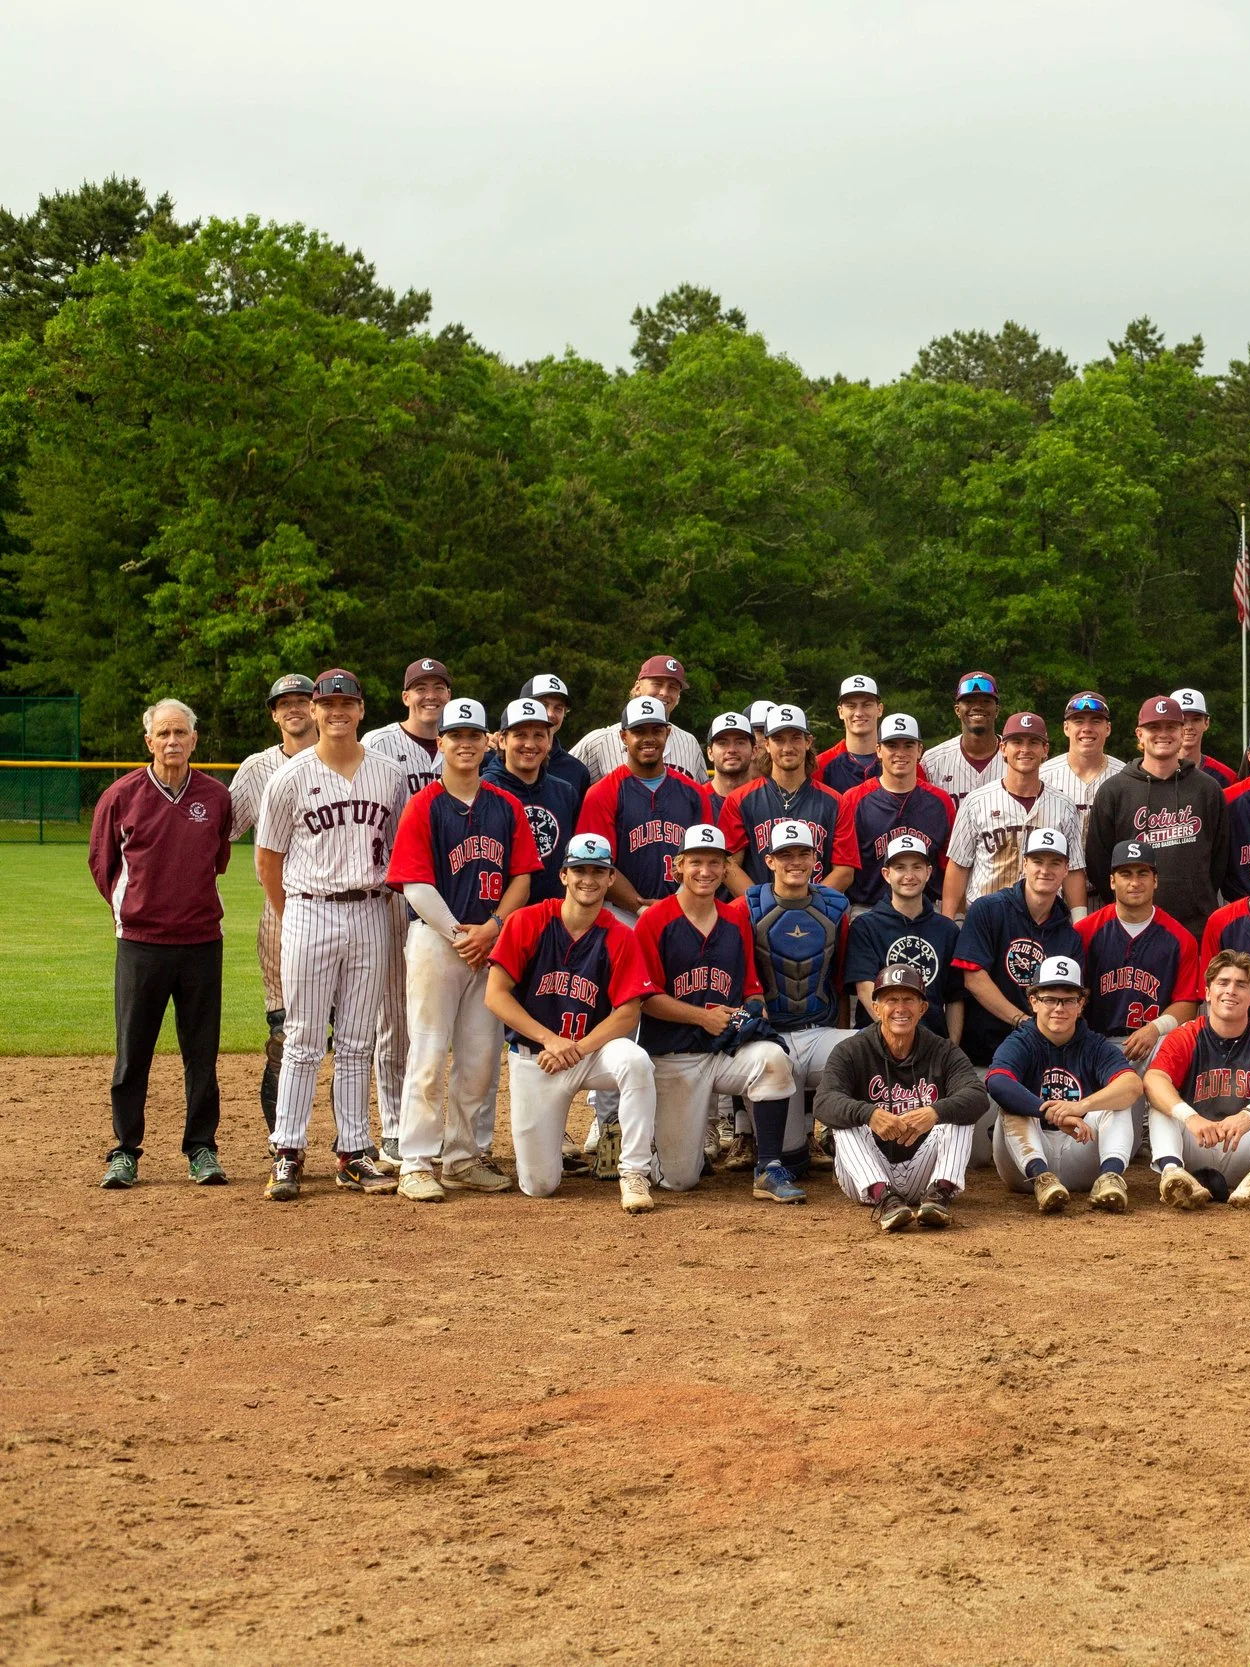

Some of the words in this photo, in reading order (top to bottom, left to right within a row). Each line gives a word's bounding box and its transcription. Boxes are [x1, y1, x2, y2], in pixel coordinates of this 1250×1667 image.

[549, 678, 561, 690] S
[853, 677, 865, 689] S
[1182, 693, 1194, 705] S
[459, 704, 472, 719] S
[522, 702, 536, 715] S
[641, 701, 654, 714] S
[781, 708, 793, 721] S
[725, 714, 737, 727] S
[894, 718, 907, 731] S
[303, 800, 391, 835] COTUIT
[538, 810, 556, 829] SOX
[1133, 804, 1192, 830] Cotuit
[629, 819, 663, 853] BLUE
[701, 829, 714, 842] S
[786, 825, 799, 839] S
[1041, 832, 1054, 845] S
[1143, 825, 1194, 843] KETTLEERS
[901, 837, 914, 848] S
[448, 835, 480, 875] BLUE
[480, 836, 504, 869] SOX
[1127, 843, 1141, 858] S
[479, 871, 503, 900] 18
[889, 939, 913, 962] BLUE
[914, 940, 935, 962] SOX
[1012, 943, 1032, 954] BLUE
[1056, 961, 1069, 976] S
[673, 966, 708, 999] BLUE
[710, 967, 732, 998] SOX
[1100, 966, 1133, 996] BLUE
[1134, 968, 1160, 1001] SOX
[569, 975, 599, 1008] SOX
[1126, 1001, 1160, 1029] 24
[559, 1011, 588, 1042] 11
[1194, 1068, 1232, 1104] BLUE
